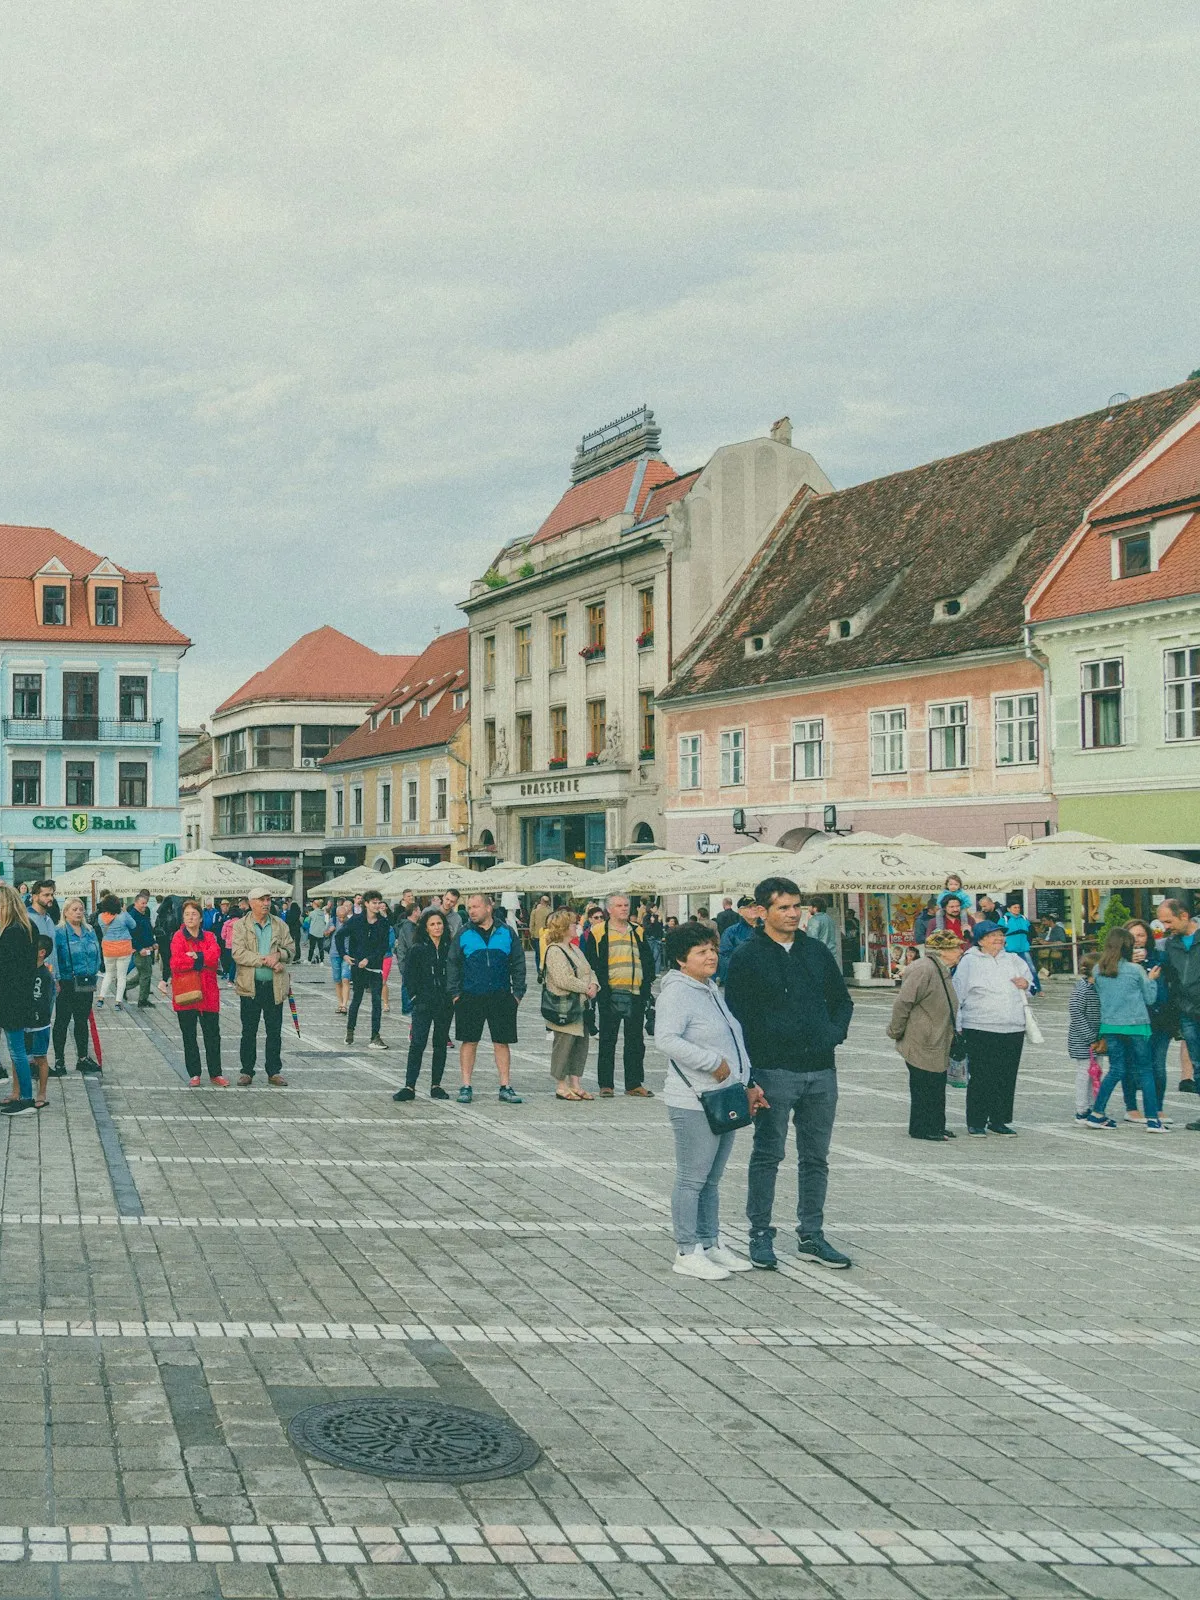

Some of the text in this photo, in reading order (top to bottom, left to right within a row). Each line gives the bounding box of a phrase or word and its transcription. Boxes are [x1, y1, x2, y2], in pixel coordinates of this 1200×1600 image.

[520, 779, 580, 796] BRASSERIE
[32, 815, 137, 830] CEC Bank
[1076, 863, 1159, 871] BRASSO
[841, 869, 969, 878] KRONSTADT
[866, 882, 896, 891] REGELE
[1081, 878, 1110, 886] REGELE
